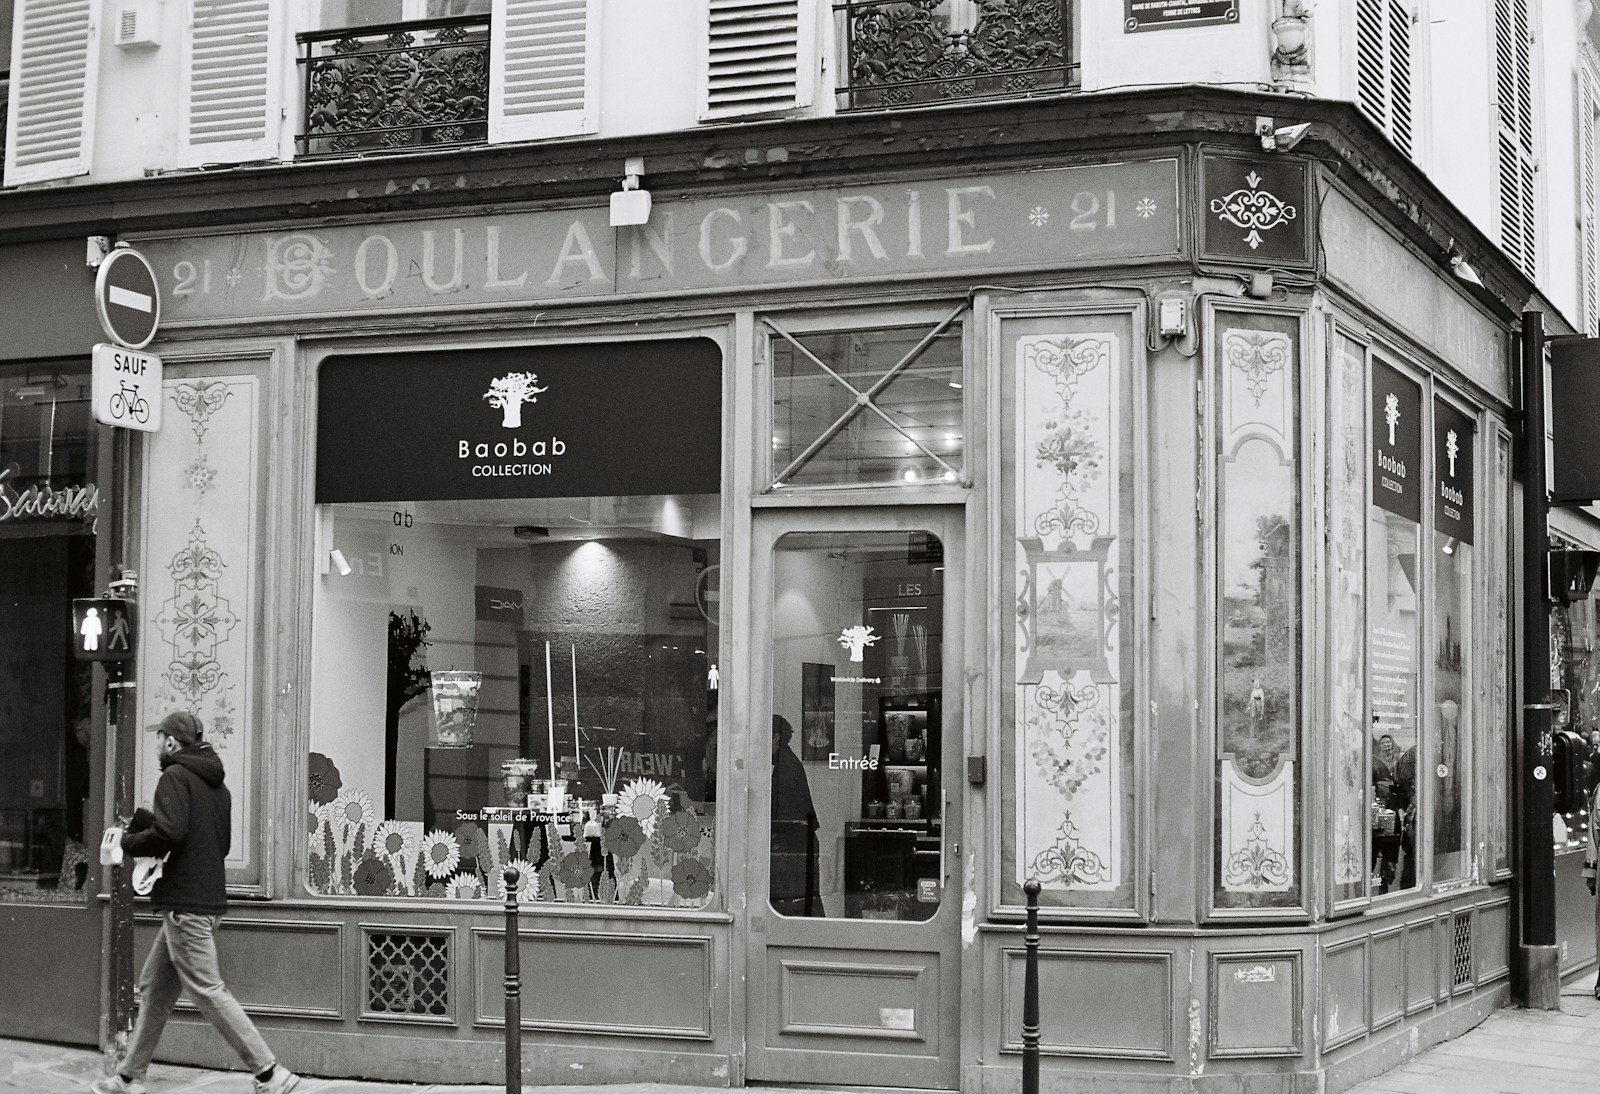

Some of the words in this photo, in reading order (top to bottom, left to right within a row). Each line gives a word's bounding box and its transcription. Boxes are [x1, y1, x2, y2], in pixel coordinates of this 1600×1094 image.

[1070, 190, 1116, 230] 21
[263, 185, 997, 301] BOULANGERIE
[172, 260, 211, 297] 21
[114, 353, 147, 376] SAUF
[458, 437, 567, 459] Baobab
[472, 463, 552, 477] COLLECTION
[1378, 449, 1406, 478] Baobab
[1441, 481, 1463, 506] Baobab
[898, 583, 922, 596] LES
[828, 752, 879, 770] Entrée
[456, 809, 477, 821] Sous
[480, 809, 488, 821] le
[490, 810, 513, 822] soleil
[515, 810, 528, 822] de
[530, 811, 571, 823] Provence
